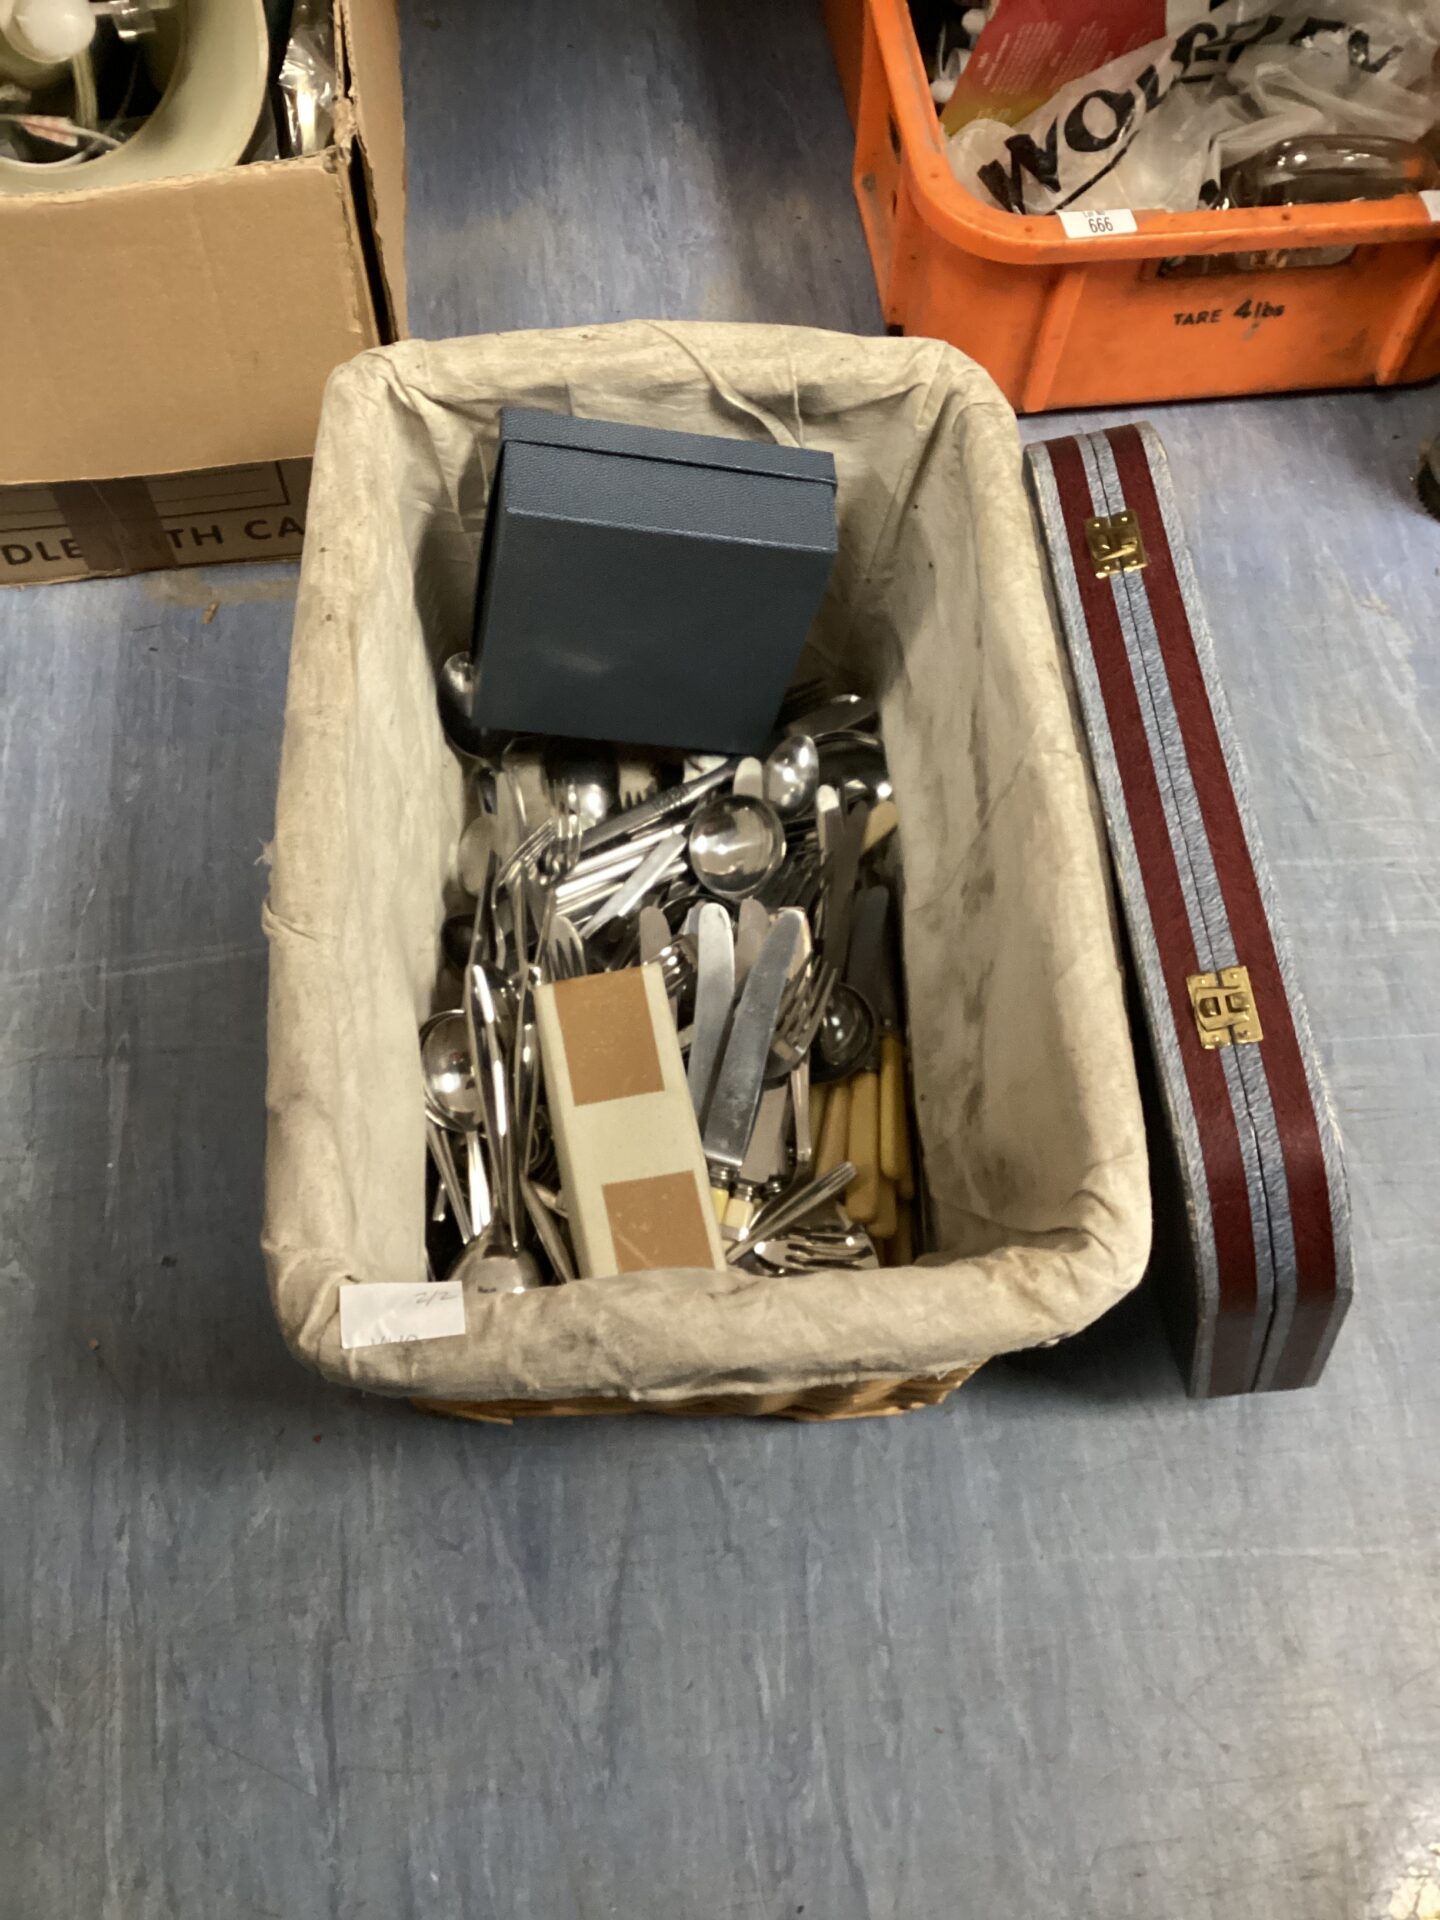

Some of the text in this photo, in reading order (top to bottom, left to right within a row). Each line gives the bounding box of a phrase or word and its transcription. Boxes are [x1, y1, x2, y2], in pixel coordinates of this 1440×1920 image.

[1088, 217, 1113, 233] 666
[1173, 309, 1222, 325] TARE
[165, 525, 224, 548] TH
